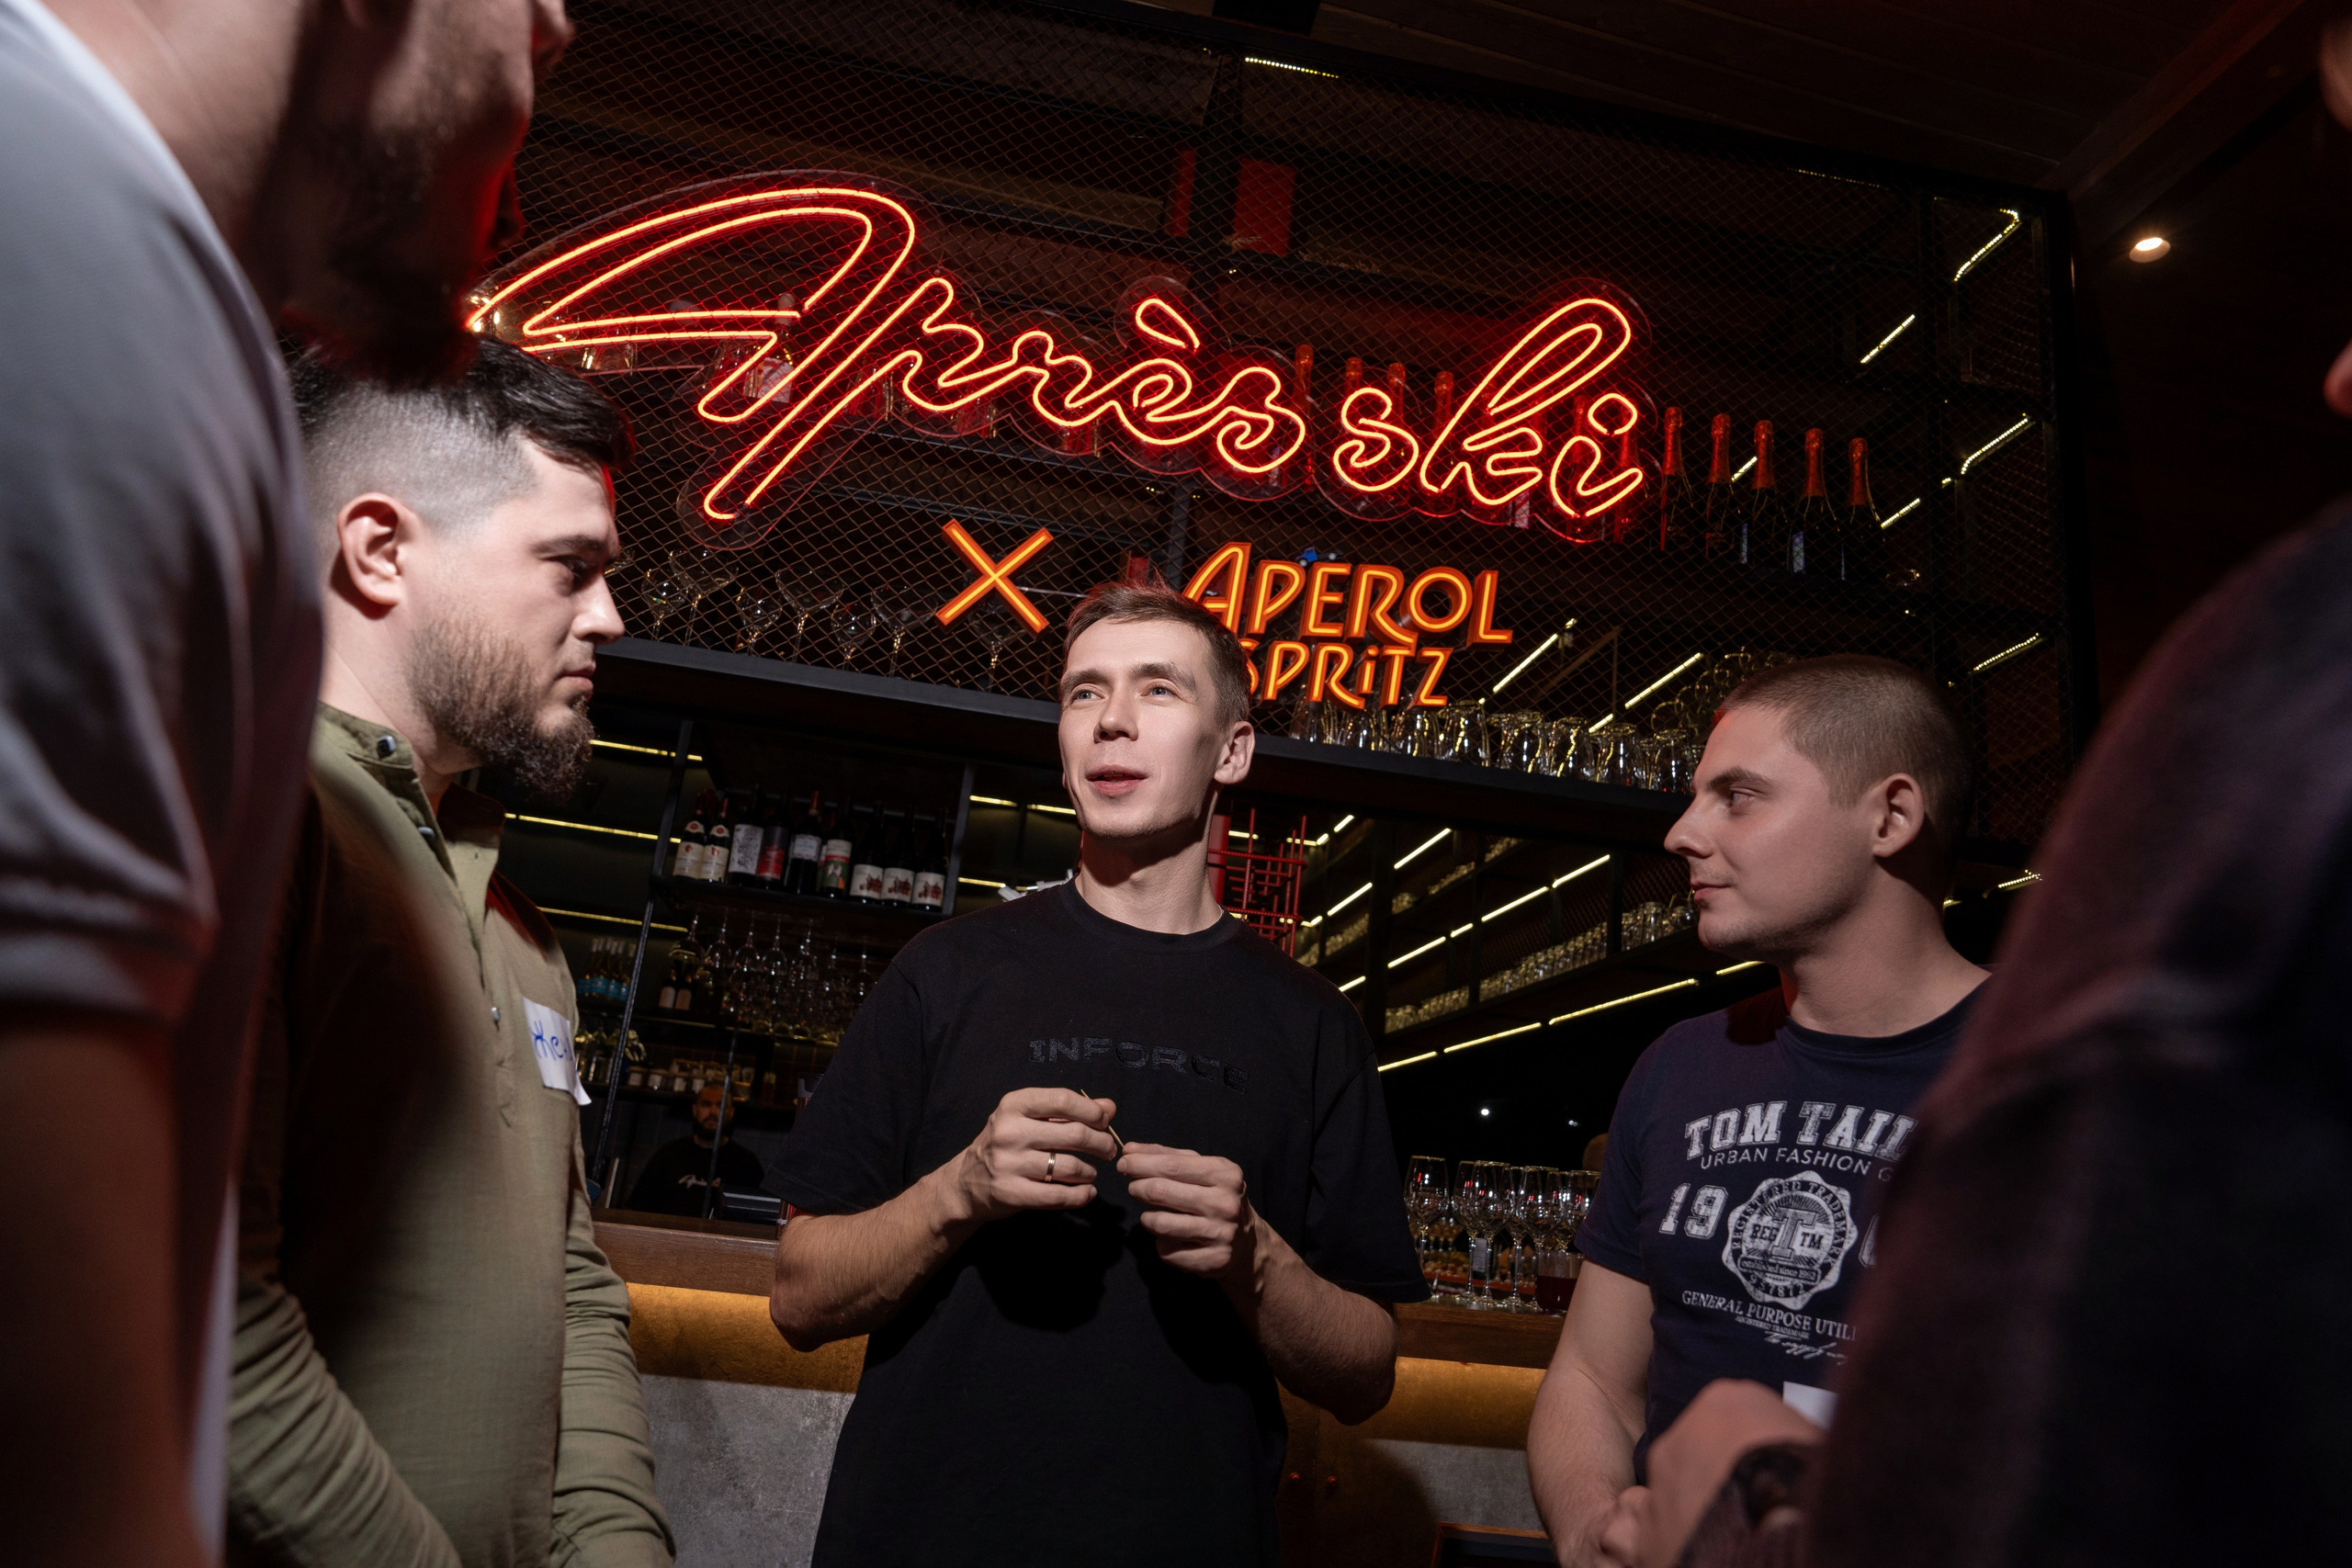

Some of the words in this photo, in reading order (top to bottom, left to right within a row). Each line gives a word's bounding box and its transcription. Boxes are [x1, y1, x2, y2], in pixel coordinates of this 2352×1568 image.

[467, 186, 1306, 522] Après
[1332, 297, 1645, 519] ski
[1182, 541, 1514, 653] APEROL
[1028, 1035, 1251, 1096] INFORCE
[1684, 1100, 1789, 1162] TOM
[1701, 1147, 1768, 1170] URBAN
[1774, 1146, 1872, 1177] FASHION
[1657, 1181, 1730, 1241] 19
[1731, 1180, 1802, 1251] REGISTERED
[1808, 1181, 1848, 1267] TRADEMARK
[1800, 1232, 1825, 1250] TM
[1681, 1290, 1744, 1315] GENERAL
[1747, 1303, 1813, 1332] PURPOSE
